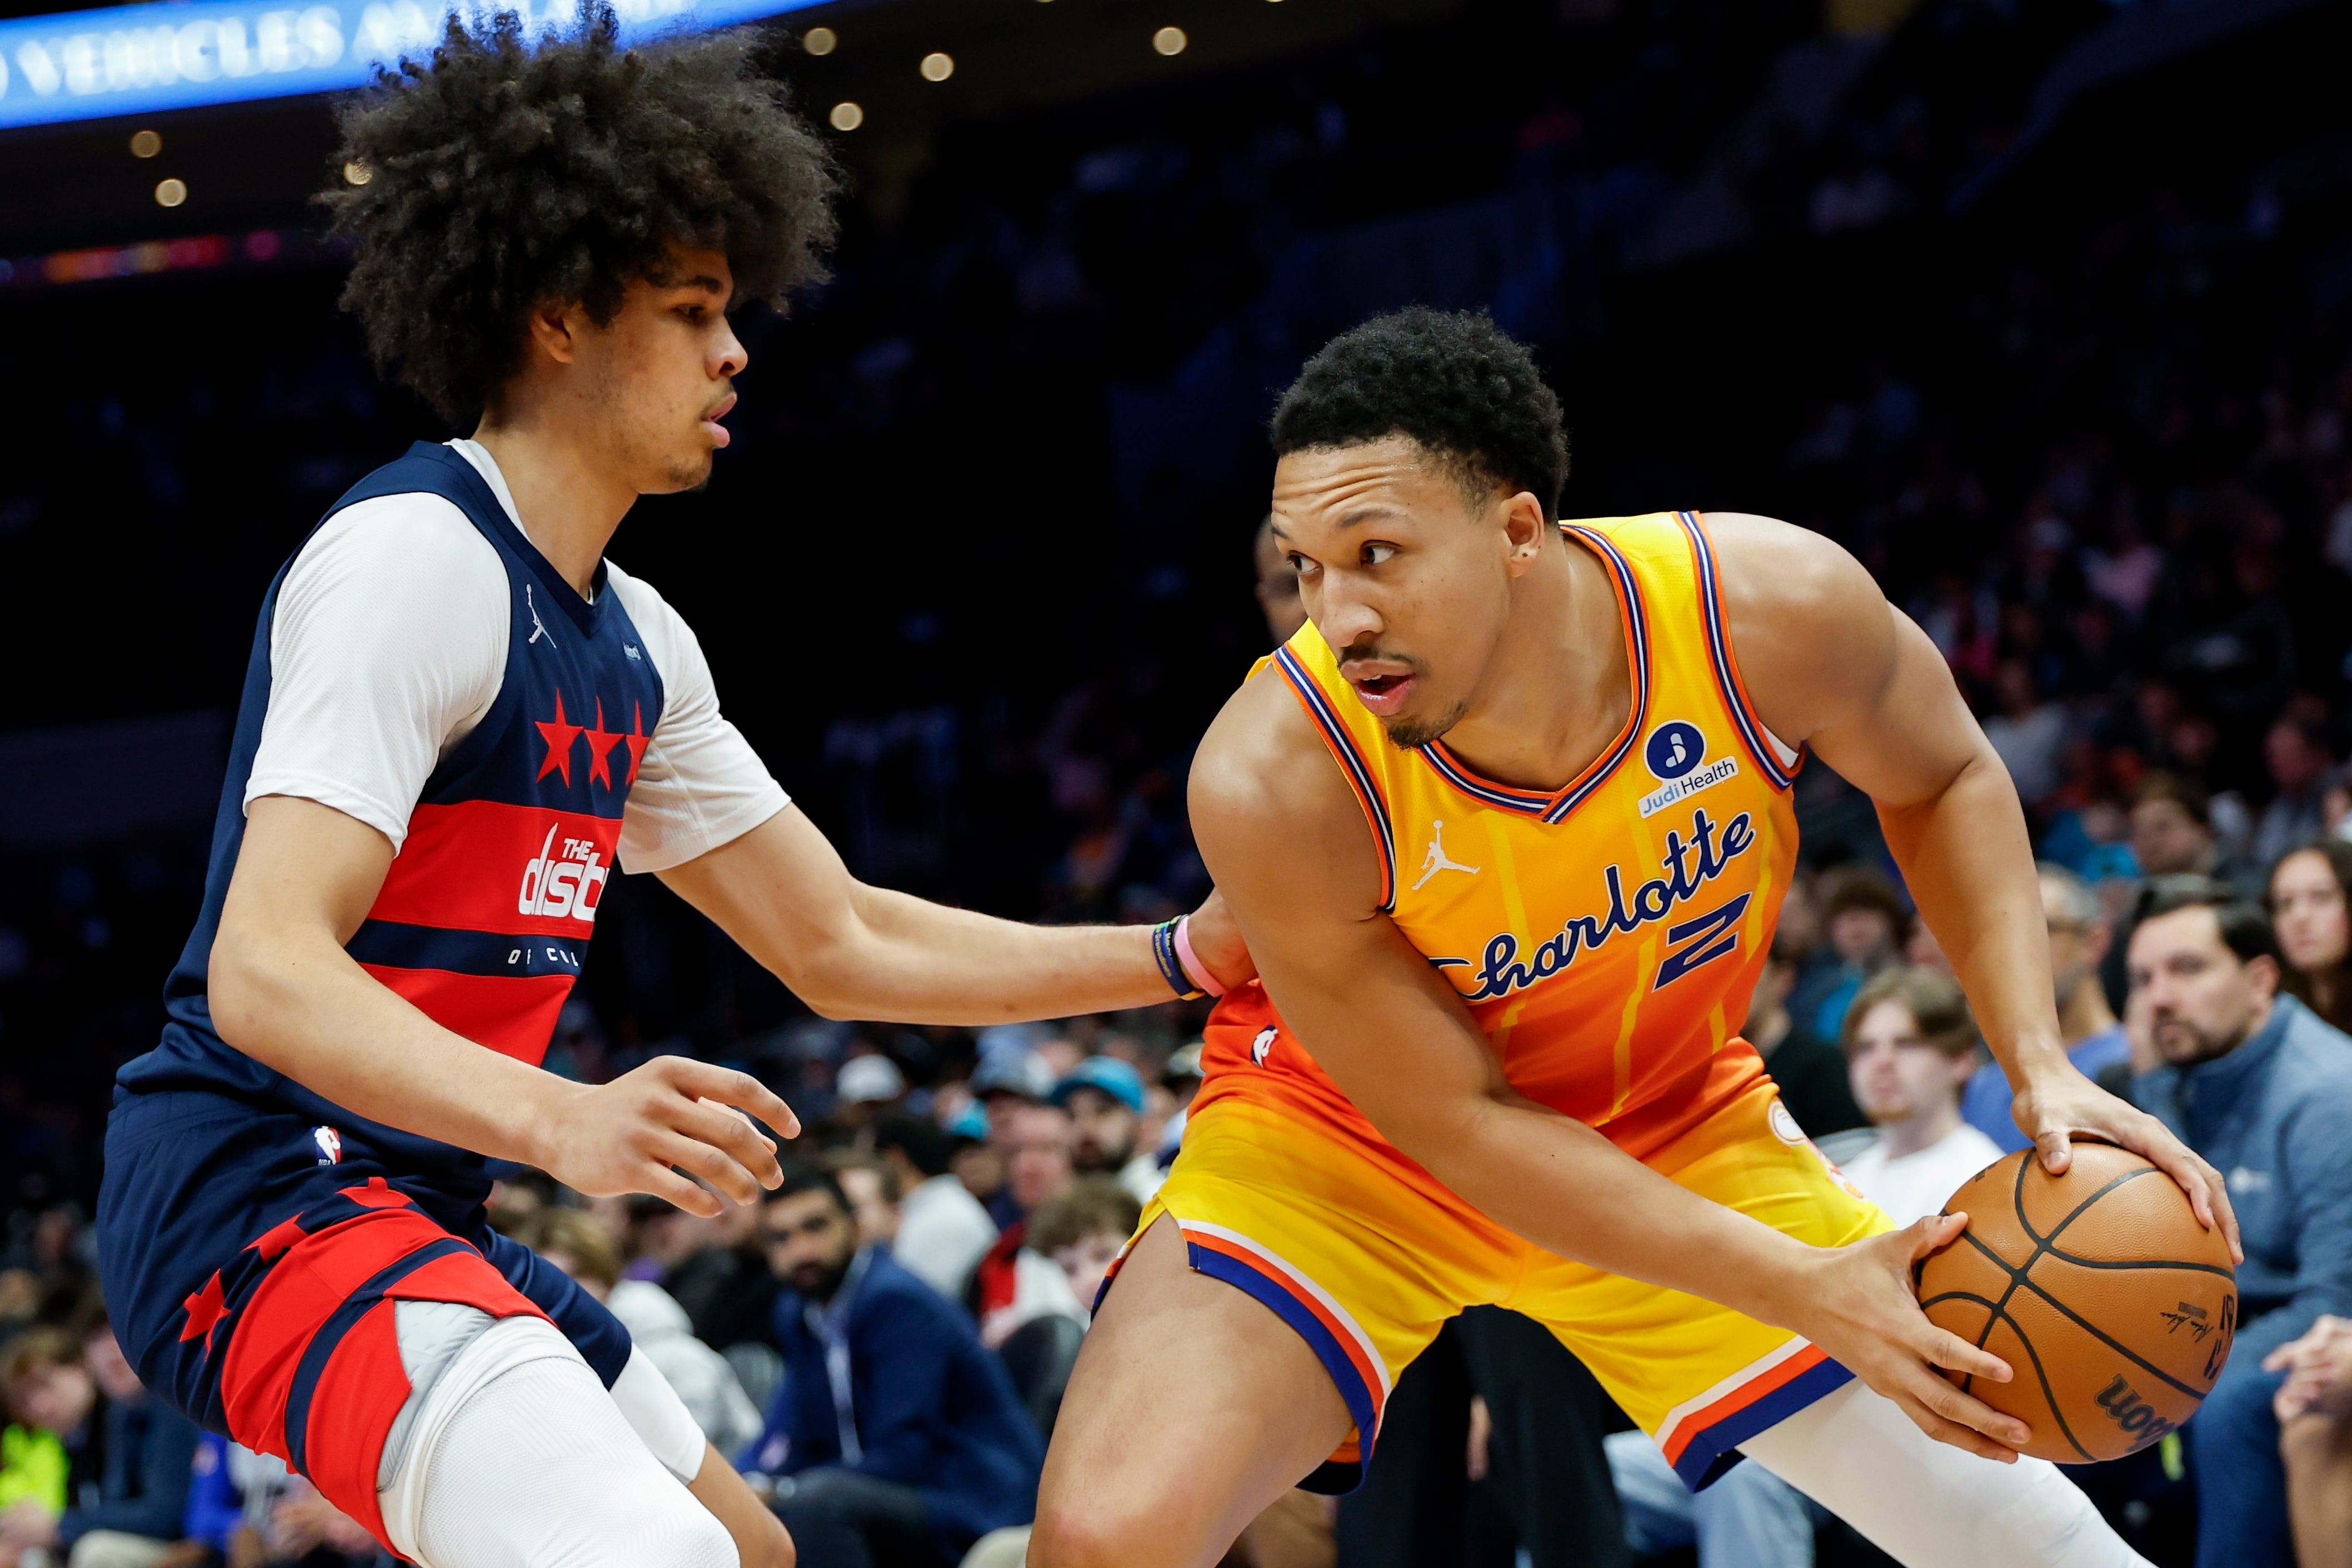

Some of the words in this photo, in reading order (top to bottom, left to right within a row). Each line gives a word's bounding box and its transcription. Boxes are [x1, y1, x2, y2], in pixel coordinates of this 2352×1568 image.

[15, 7, 344, 96] VEHICLES
[1643, 783, 1680, 815] Judi
[1680, 760, 1736, 795] Health
[562, 838, 594, 861] THE
[1651, 891, 1753, 992] 2
